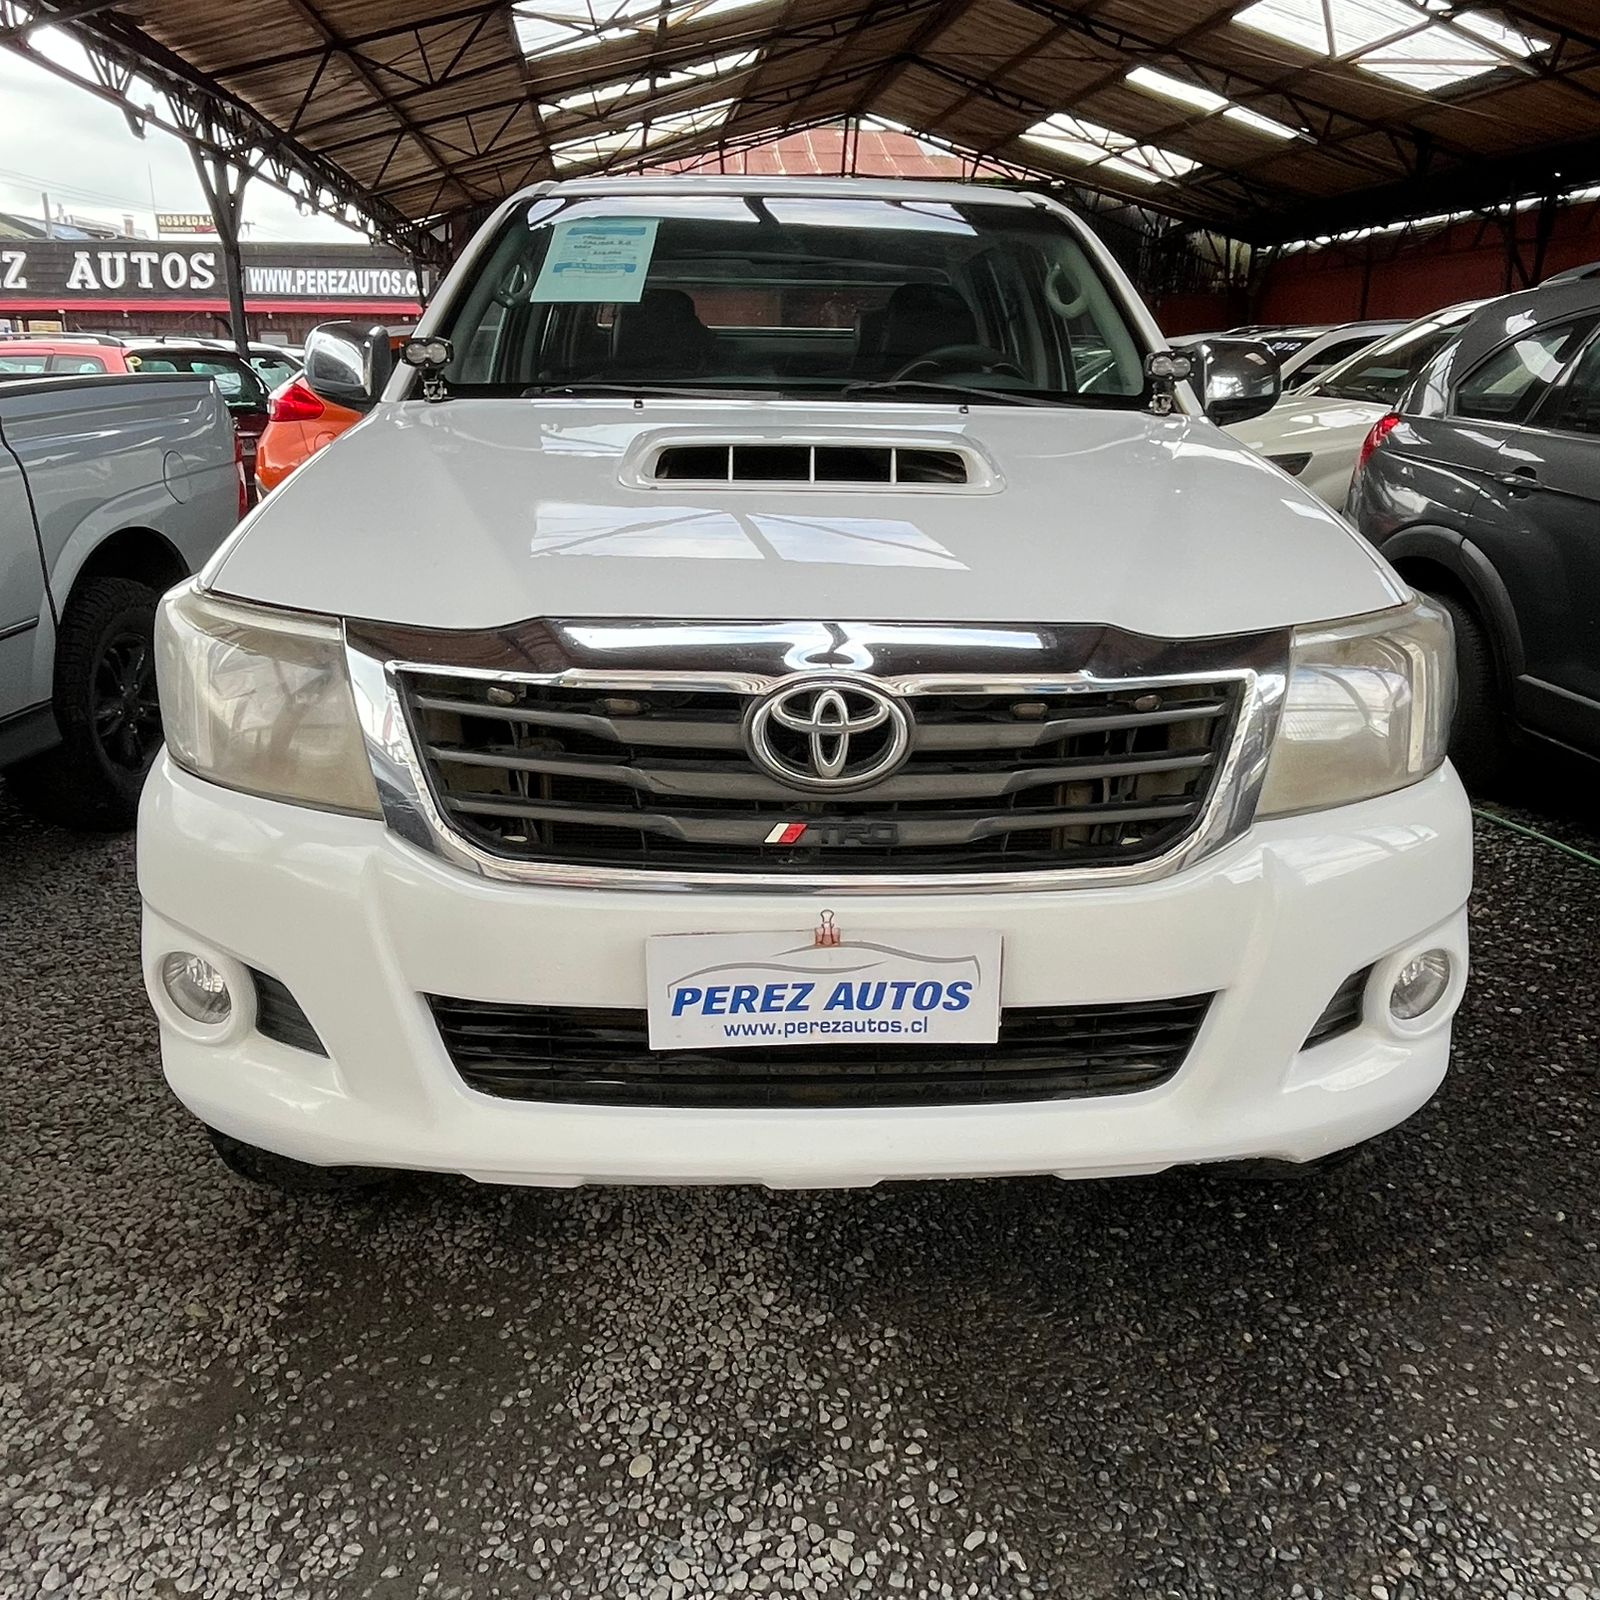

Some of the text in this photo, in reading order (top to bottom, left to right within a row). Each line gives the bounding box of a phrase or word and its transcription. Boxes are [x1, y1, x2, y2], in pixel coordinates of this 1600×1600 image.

[0, 251, 215, 289] Z AUTOS
[249, 268, 428, 297] WWW.PEREZAUTOS.C
[807, 822, 899, 845] TRD
[671, 980, 973, 1017] PEREZ AUTOS
[723, 1016, 928, 1038] www.perezautos.cl
